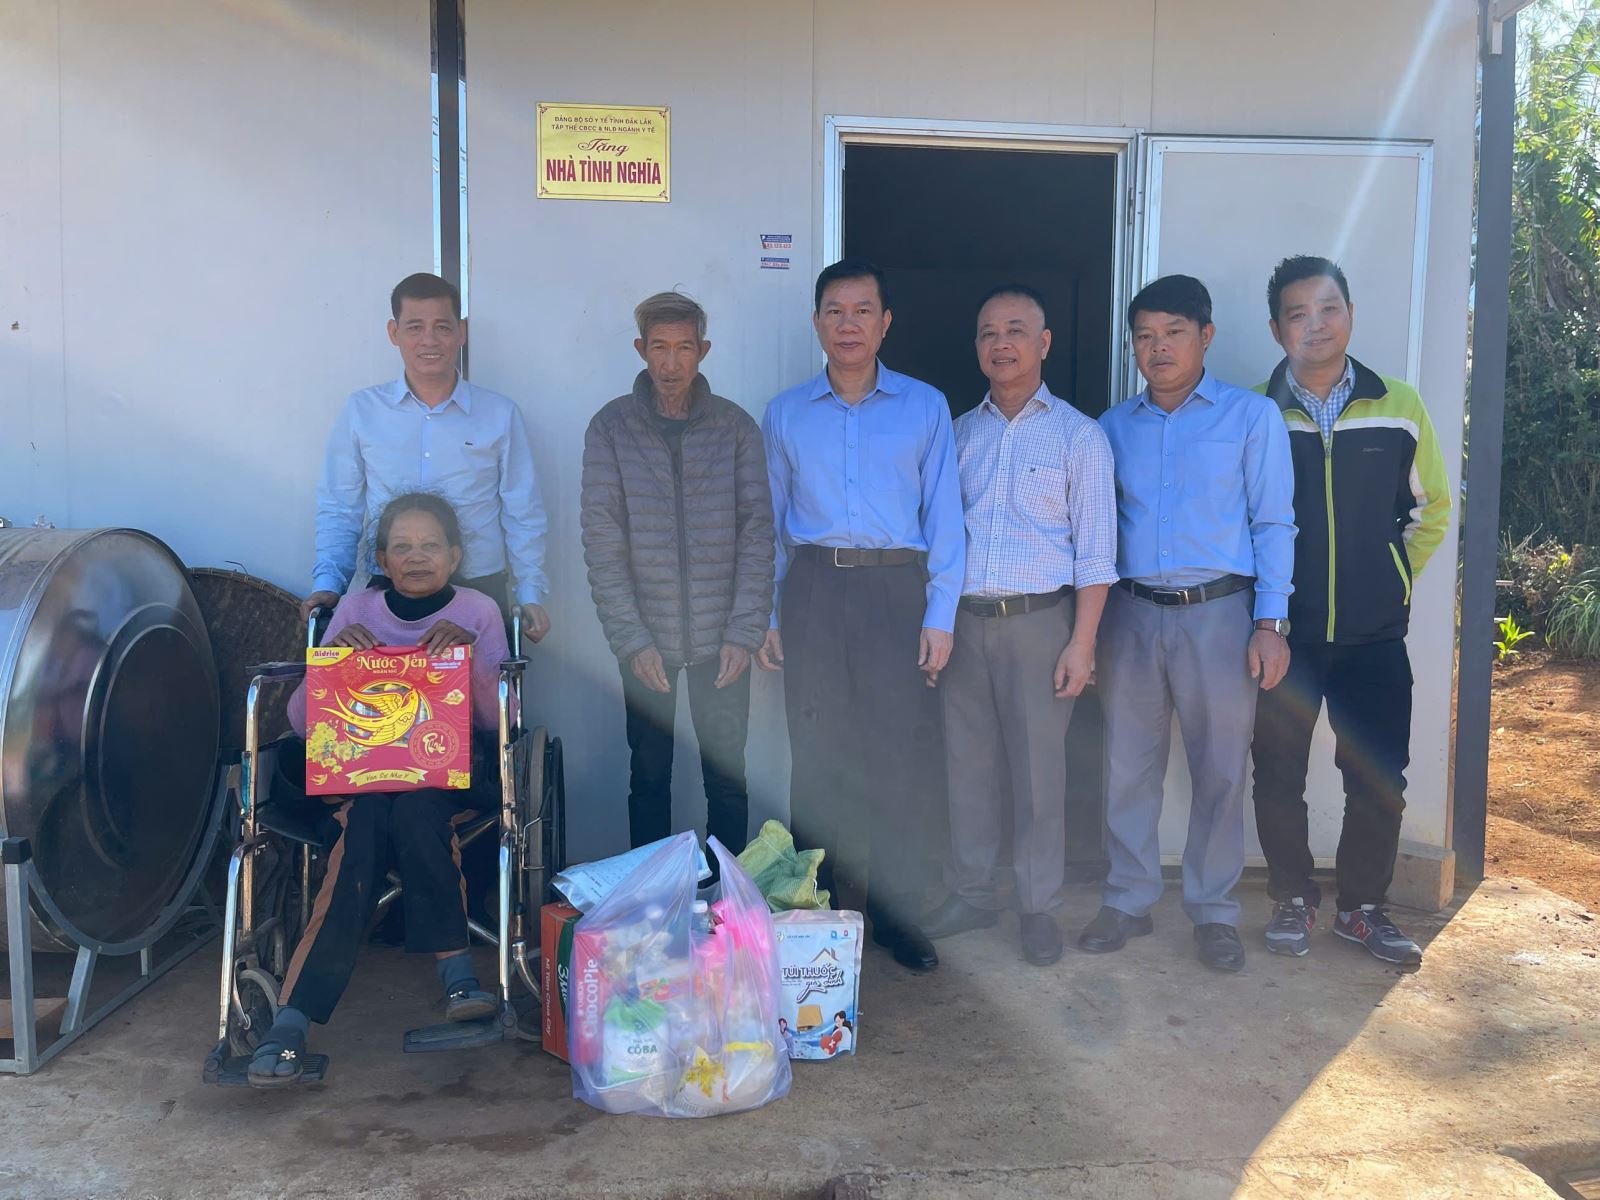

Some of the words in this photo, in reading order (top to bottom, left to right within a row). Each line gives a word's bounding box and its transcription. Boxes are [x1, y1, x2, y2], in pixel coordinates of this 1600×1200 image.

[578, 138, 629, 156] Tặng
[546, 155, 576, 182] NHÀ
[579, 155, 612, 183] TÌNH
[617, 158, 661, 184] NGHĨA
[356, 655, 397, 670] Nước
[397, 655, 427, 677] Yến
[782, 965, 799, 977] TÚI
[800, 963, 836, 978] THUỐC
[582, 958, 599, 1038] ChocoPie
